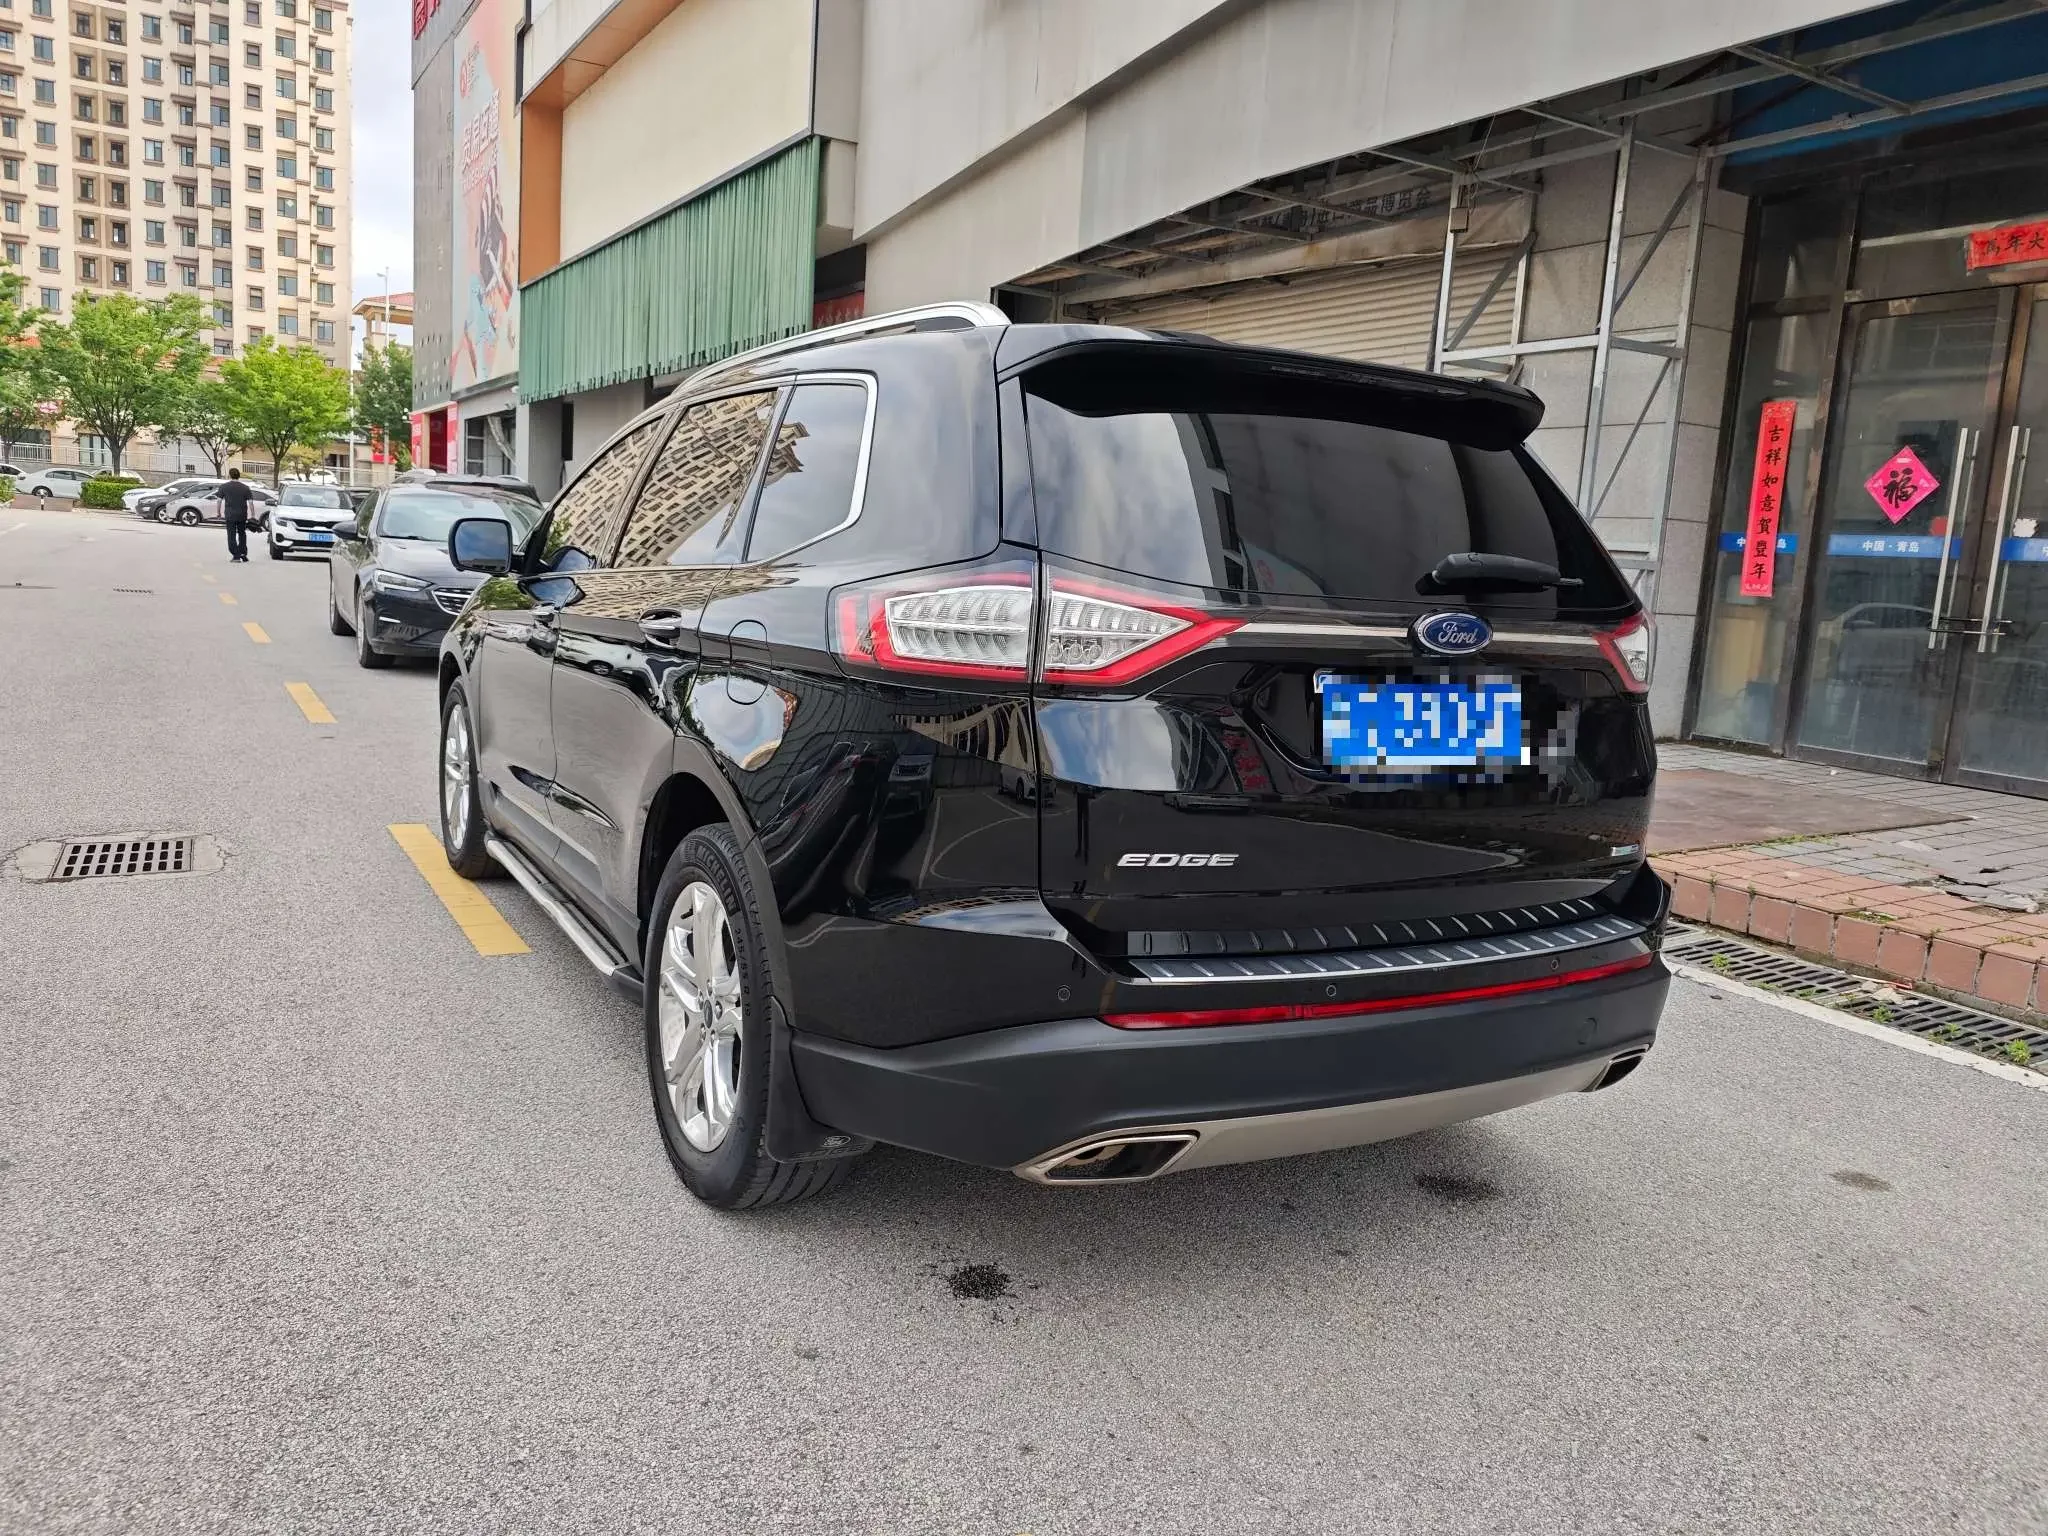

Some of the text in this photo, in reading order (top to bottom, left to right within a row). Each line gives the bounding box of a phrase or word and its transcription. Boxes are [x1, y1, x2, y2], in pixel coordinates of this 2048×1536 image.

[1882, 467, 1919, 509] 福
[1438, 621, 1479, 644] Ford
[1117, 853, 1239, 867] EDGE
[696, 845, 738, 911] MICHELIN
